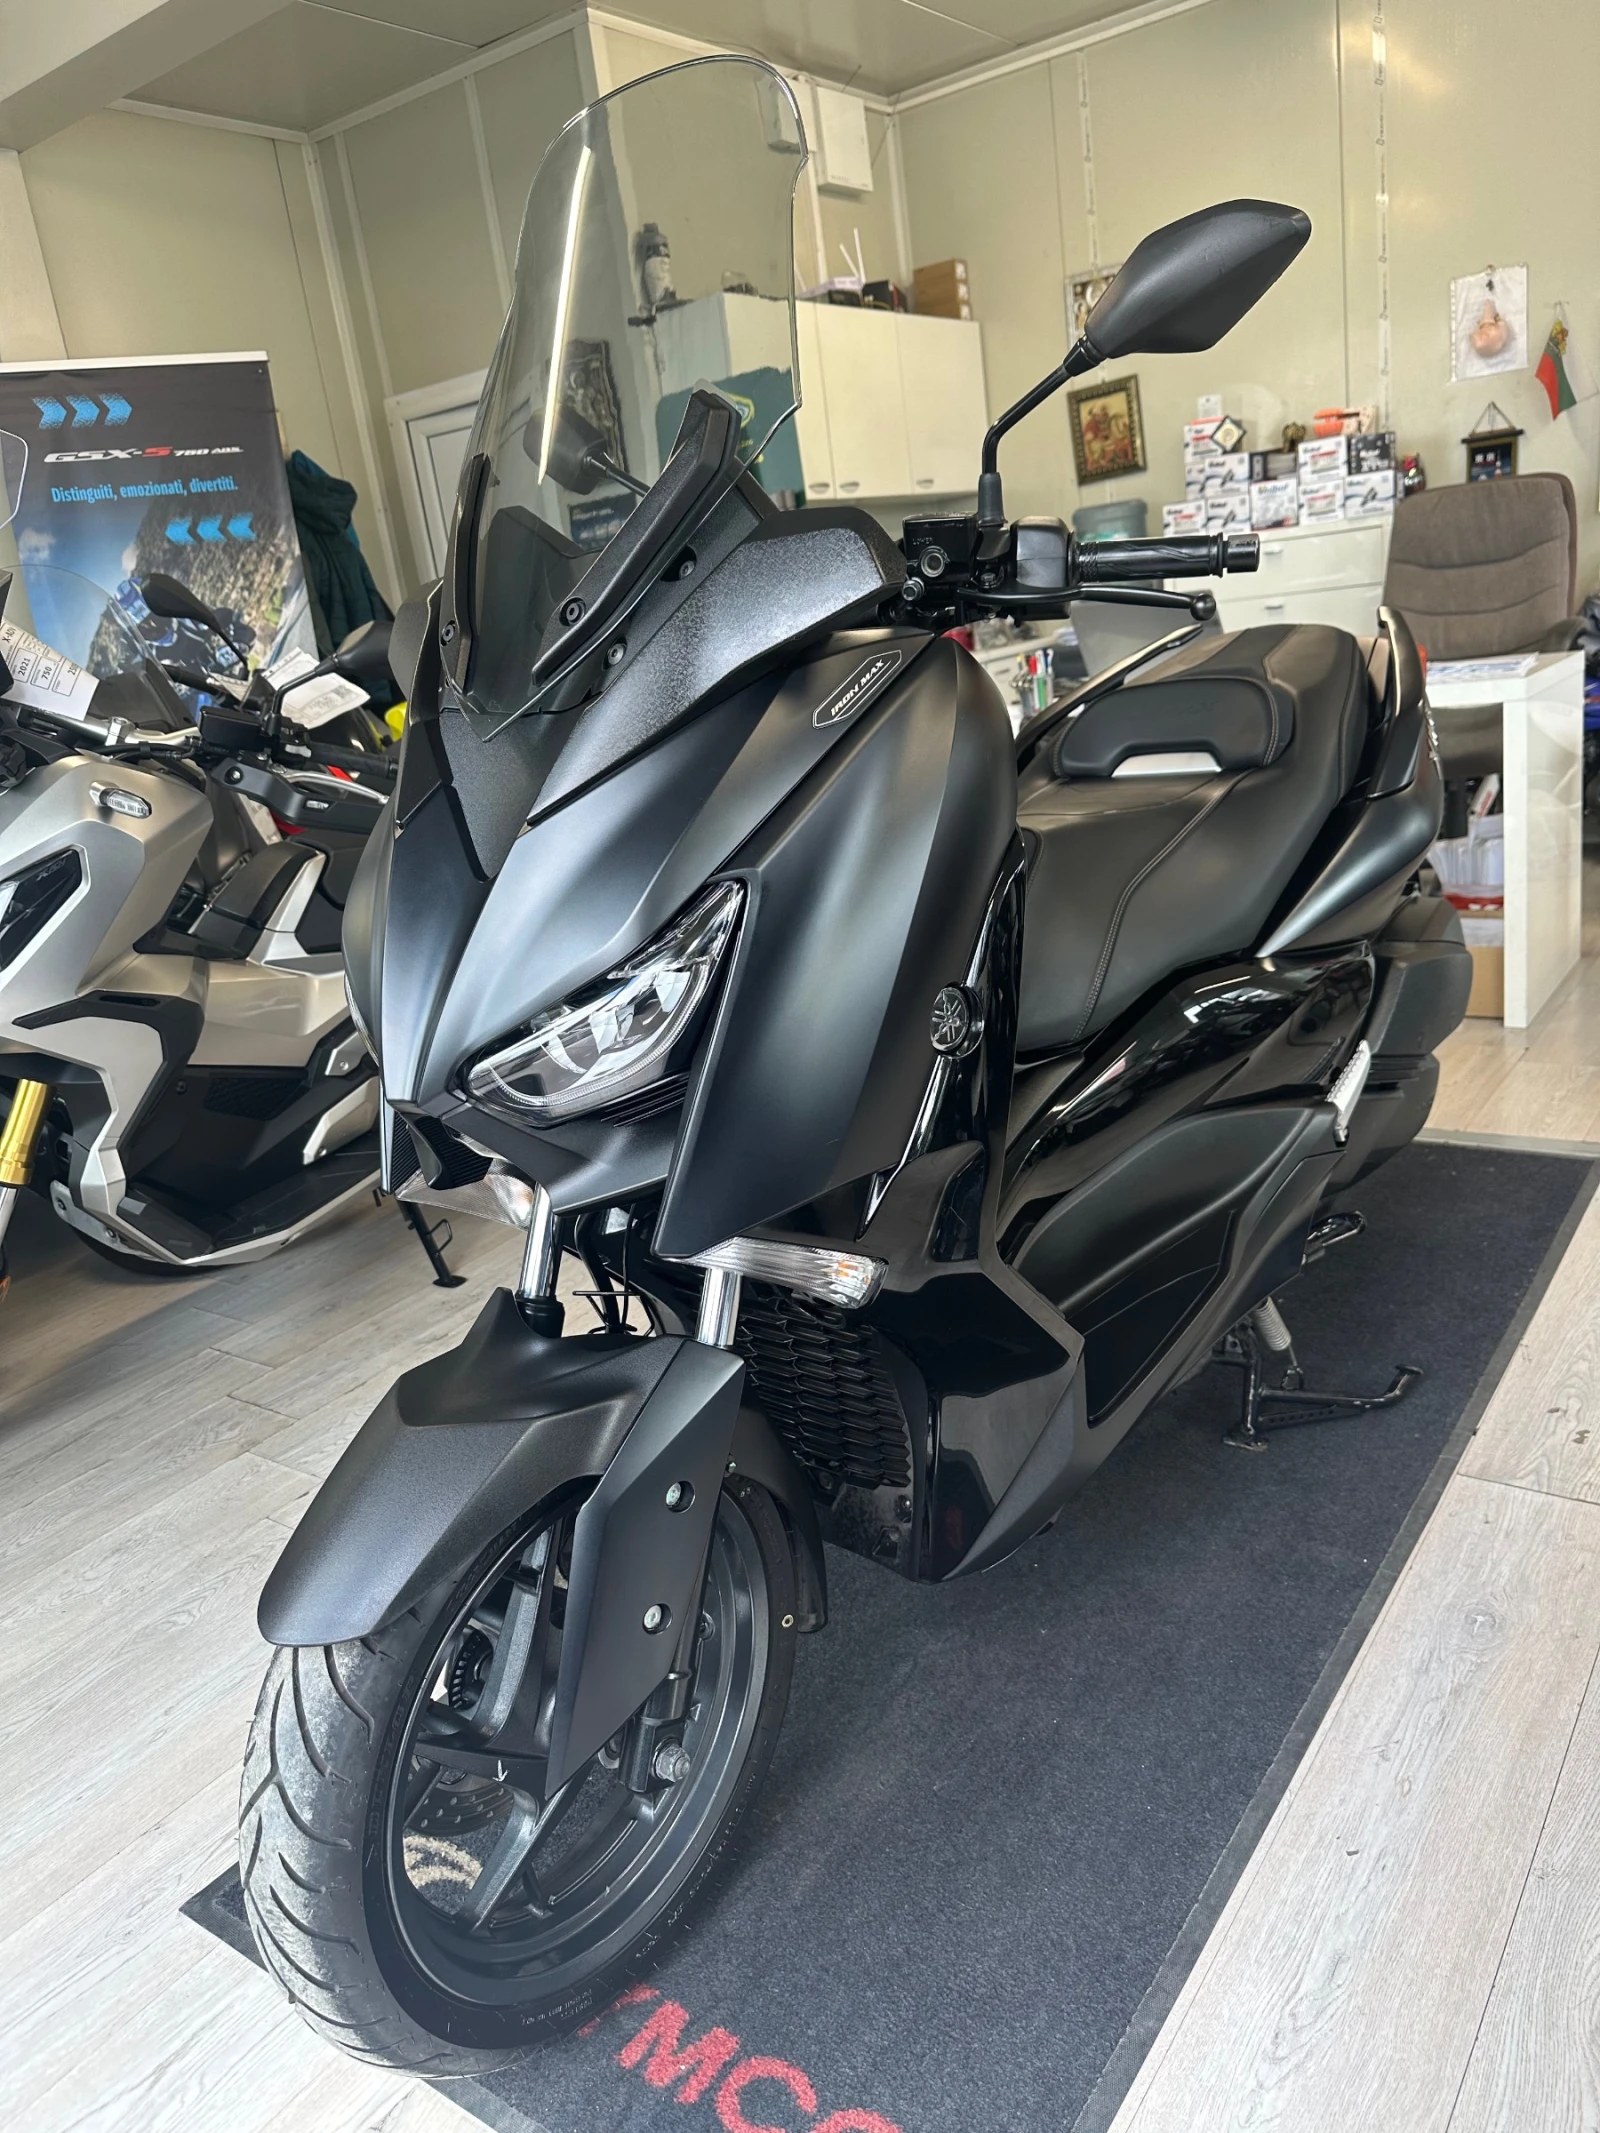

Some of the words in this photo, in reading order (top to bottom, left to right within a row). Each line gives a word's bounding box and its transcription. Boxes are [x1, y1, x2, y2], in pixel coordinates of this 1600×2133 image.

[51, 484, 118, 504] Distinguiti,
[120, 478, 187, 499] emozionati,
[189, 475, 239, 494] divertiti.
[17, 657, 31, 677] 2021
[41, 666, 53, 680] 750
[830, 683, 860, 716] IRON
[860, 659, 885, 687] MAX
